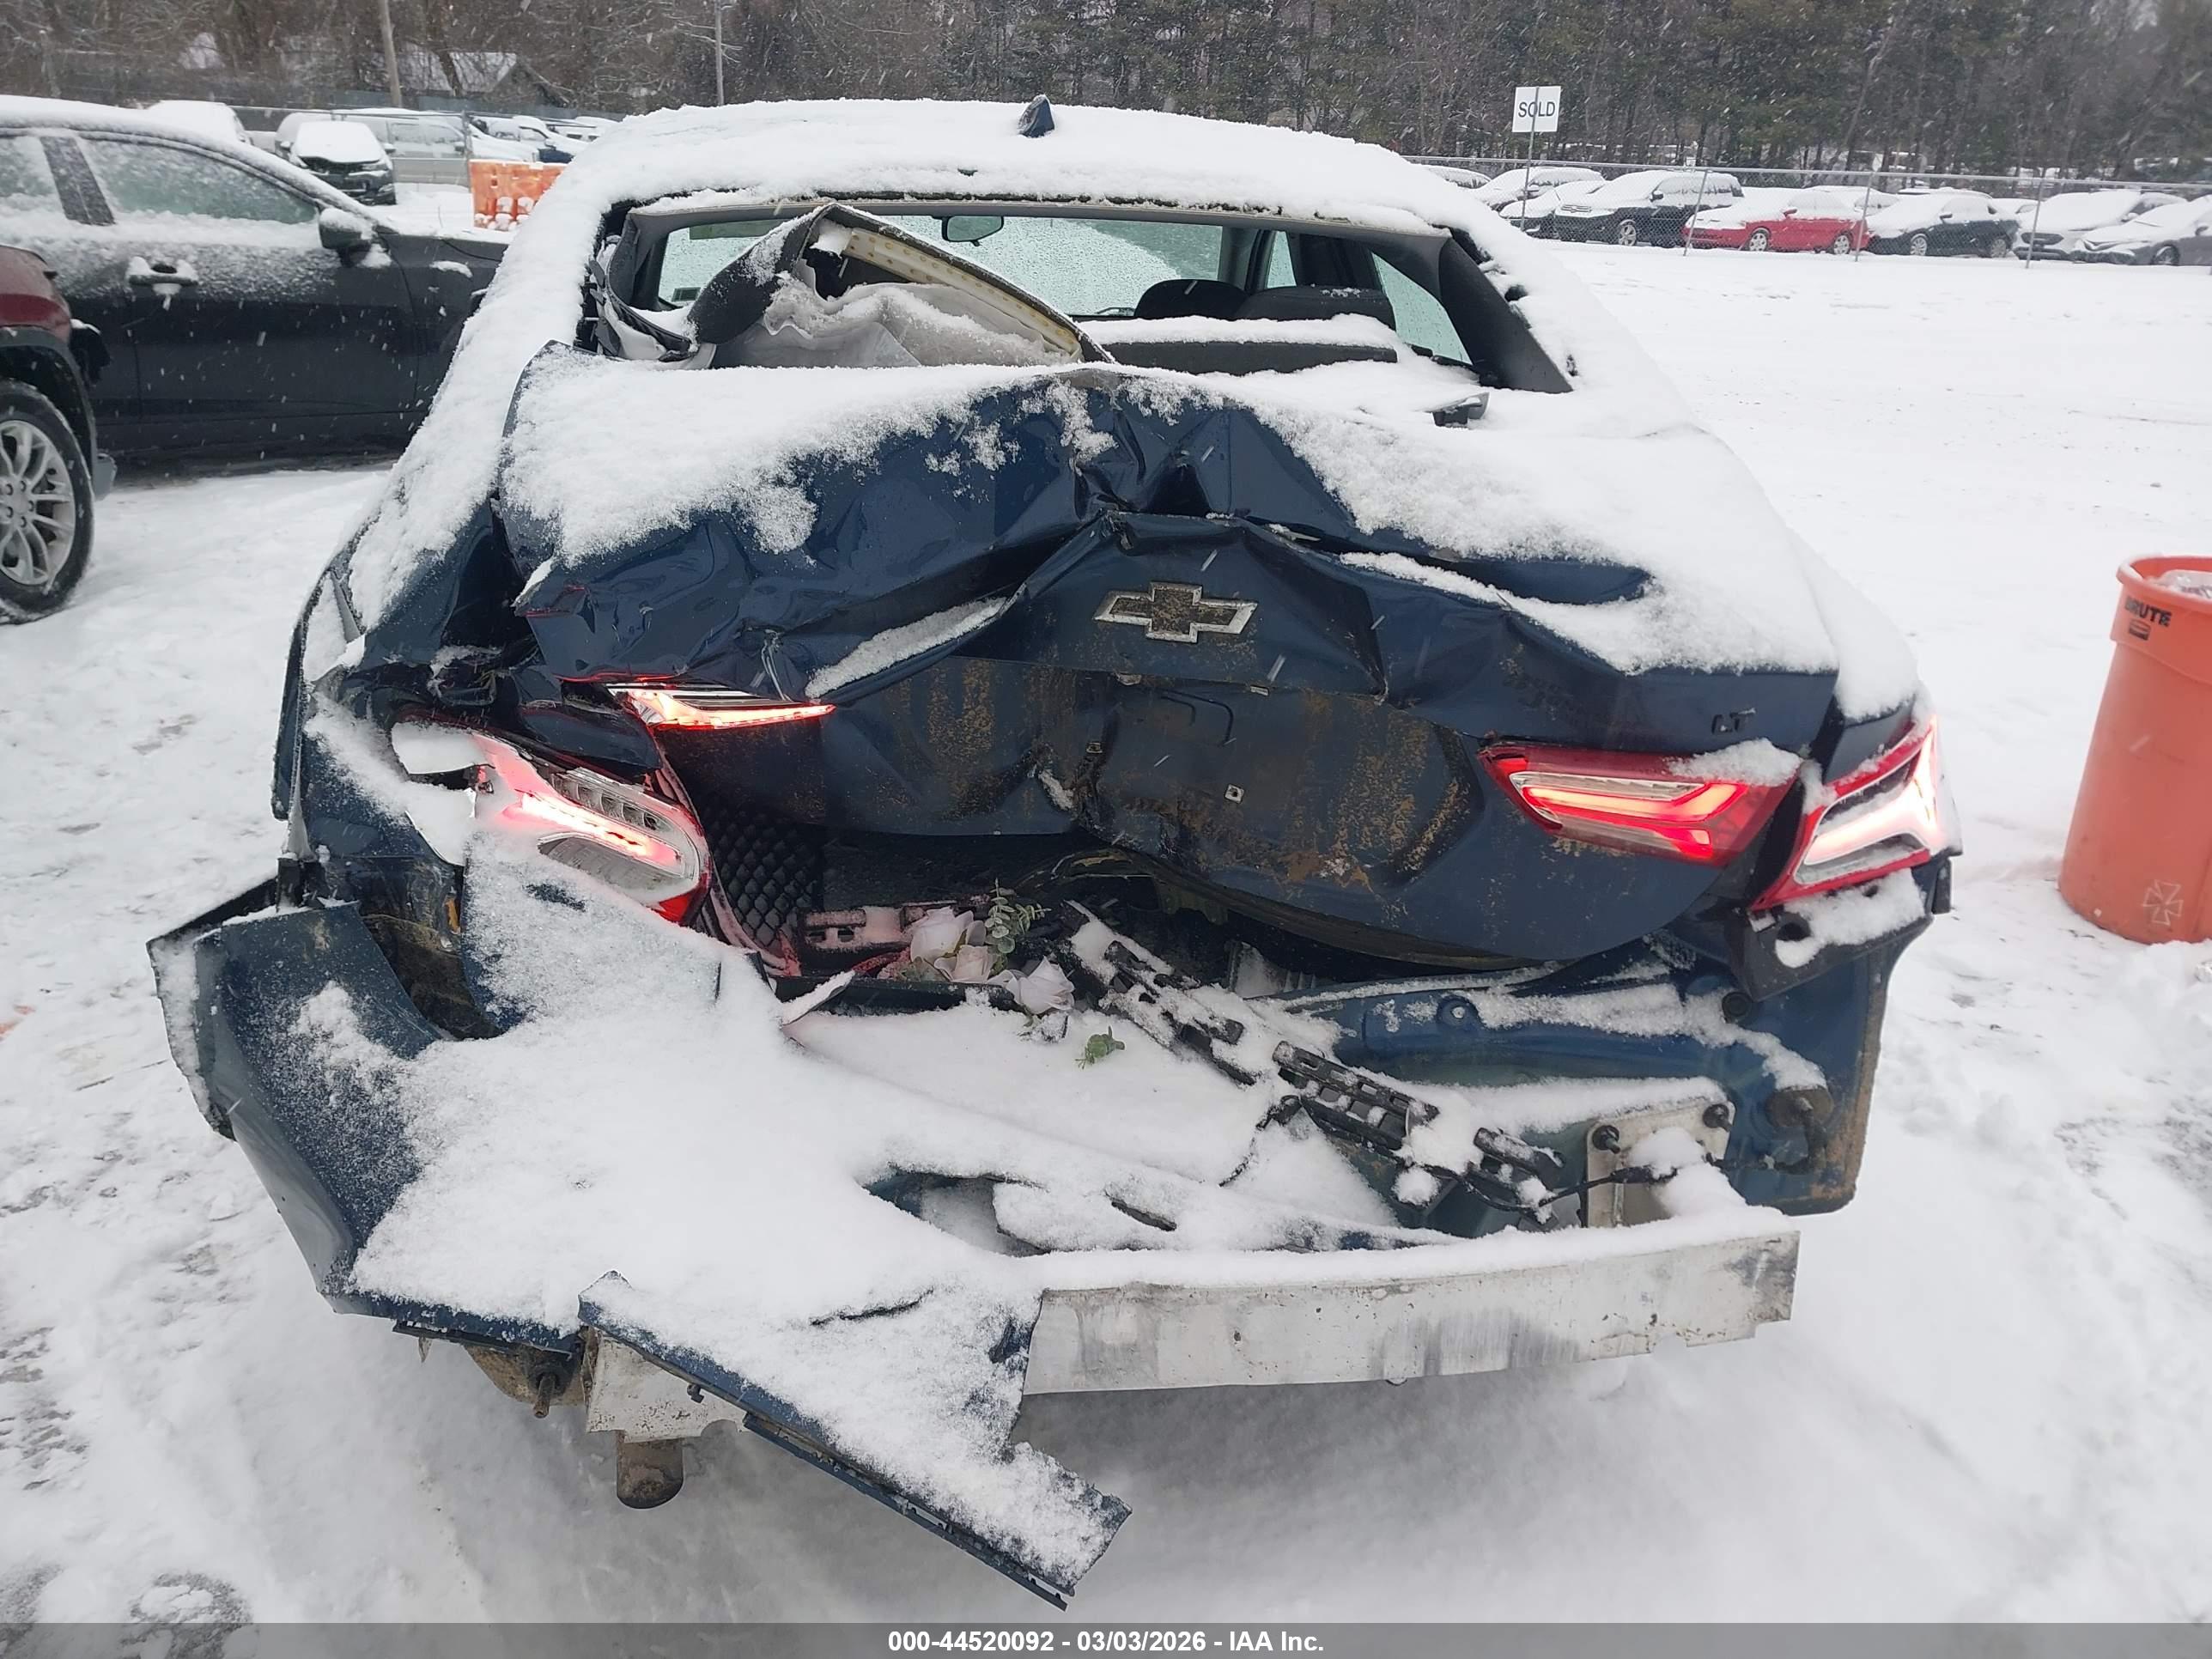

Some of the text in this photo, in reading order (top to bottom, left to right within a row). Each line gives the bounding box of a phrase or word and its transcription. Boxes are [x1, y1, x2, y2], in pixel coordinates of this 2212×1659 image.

[1517, 100, 1556, 118] SOLD
[2124, 595, 2172, 628] BRUTE
[1711, 708, 1757, 734] LT
